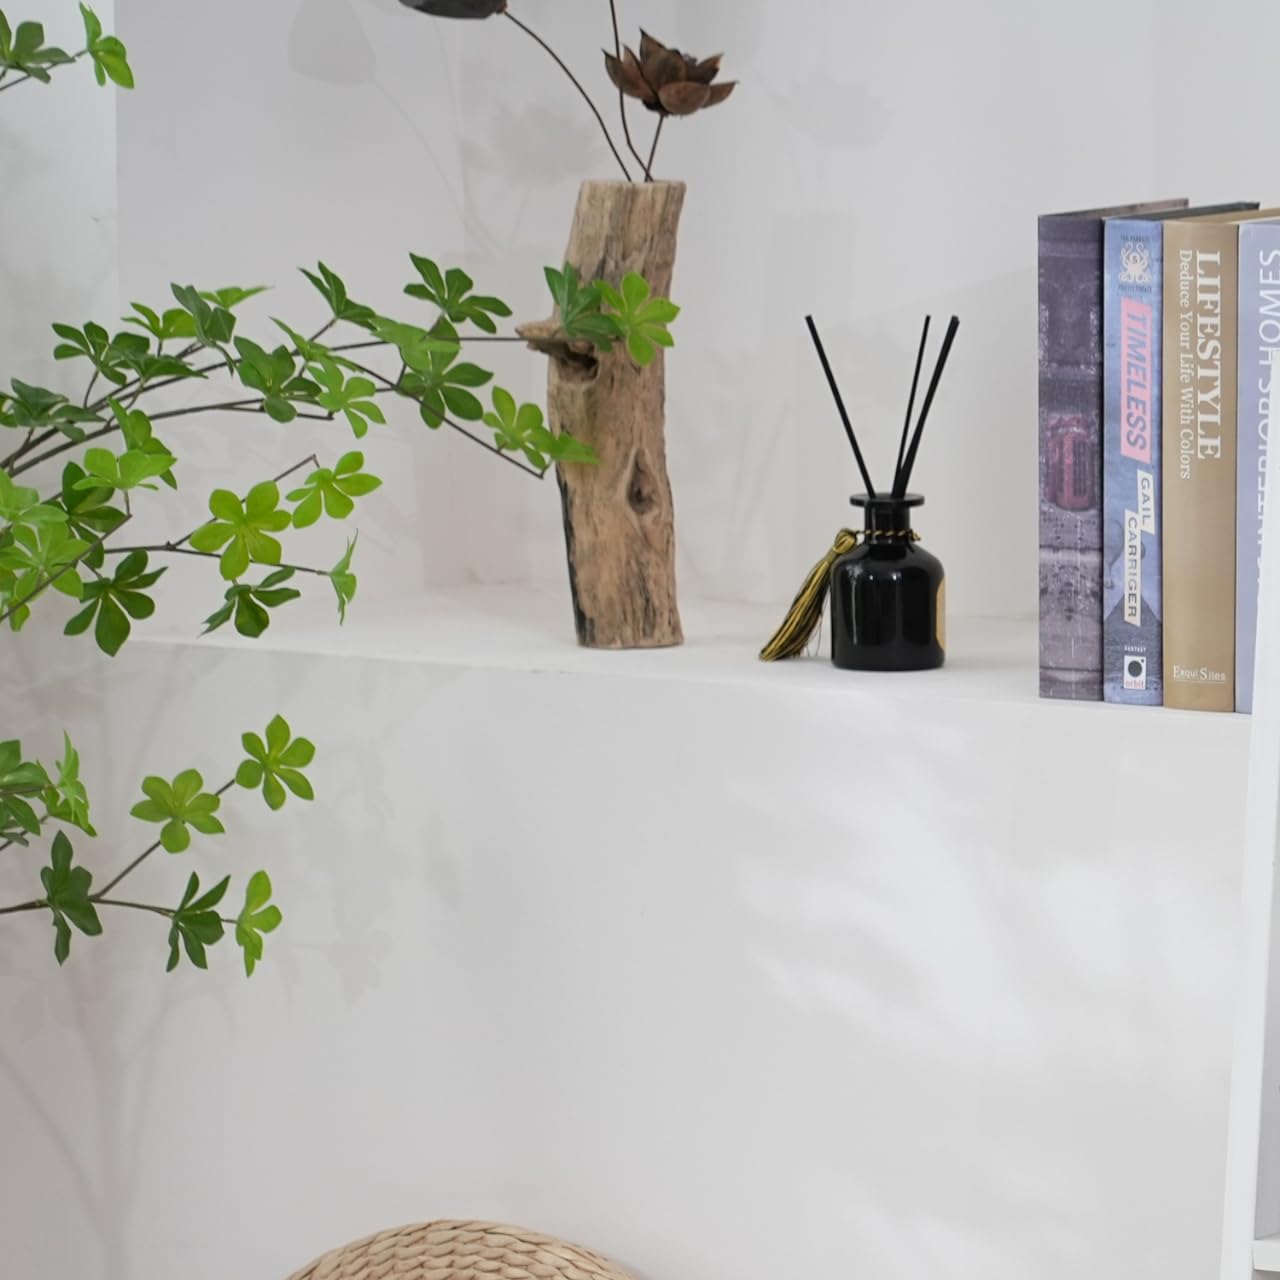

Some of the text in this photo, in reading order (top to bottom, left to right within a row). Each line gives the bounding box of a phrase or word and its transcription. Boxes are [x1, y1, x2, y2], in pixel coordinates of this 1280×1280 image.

[1126, 313, 1147, 451] TIMELESS
[1179, 249, 1194, 479] Deduce Your Life With Colors
[1196, 250, 1221, 459] LIFESTYLE
[1127, 517, 1138, 619] CARRIGER
[1140, 477, 1151, 527] GAIL
